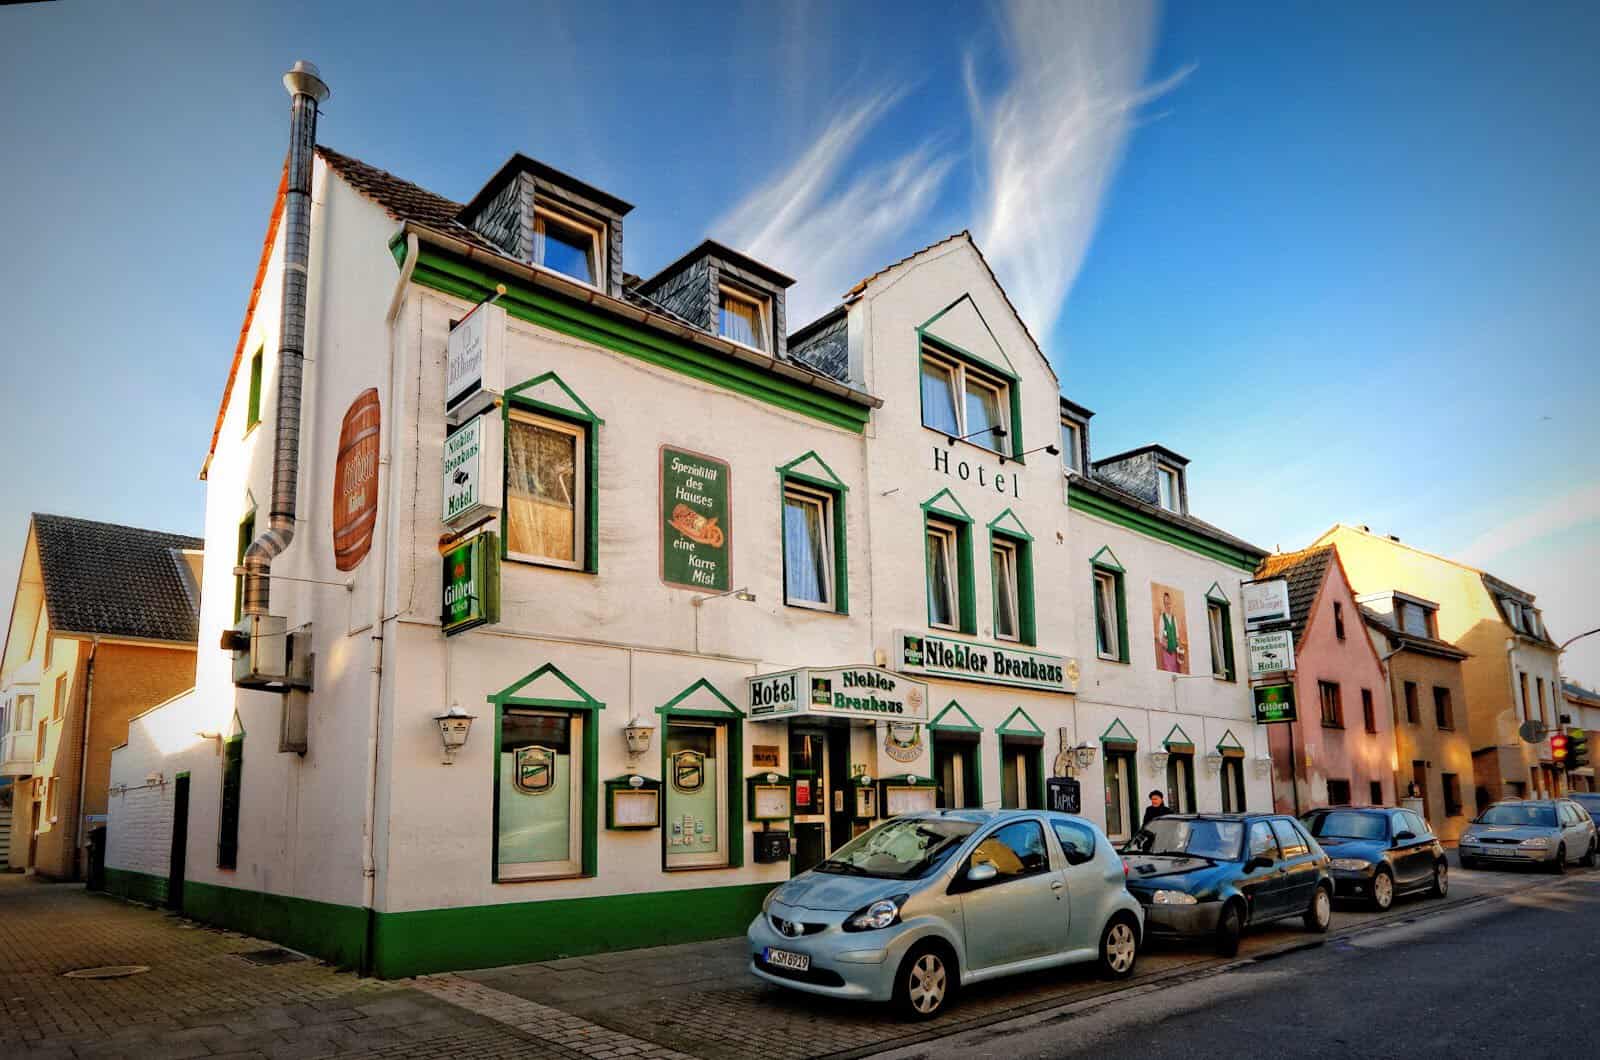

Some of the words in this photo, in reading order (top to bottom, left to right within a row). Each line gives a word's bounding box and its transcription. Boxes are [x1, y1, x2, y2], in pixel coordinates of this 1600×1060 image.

[933, 447, 1018, 498] Hotel
[686, 477, 704, 490] des
[448, 484, 472, 515] Hotel
[675, 487, 713, 508] Hauses
[673, 537, 695, 552] eine
[688, 554, 716, 571] Karre
[692, 569, 715, 585] Mist
[925, 640, 988, 673] Niehler
[993, 651, 1063, 683] Brauhaus
[1258, 660, 1283, 671] Hotel
[751, 676, 796, 706] Hotel
[842, 671, 896, 692] Niehler
[833, 692, 903, 714] Brauhaus
